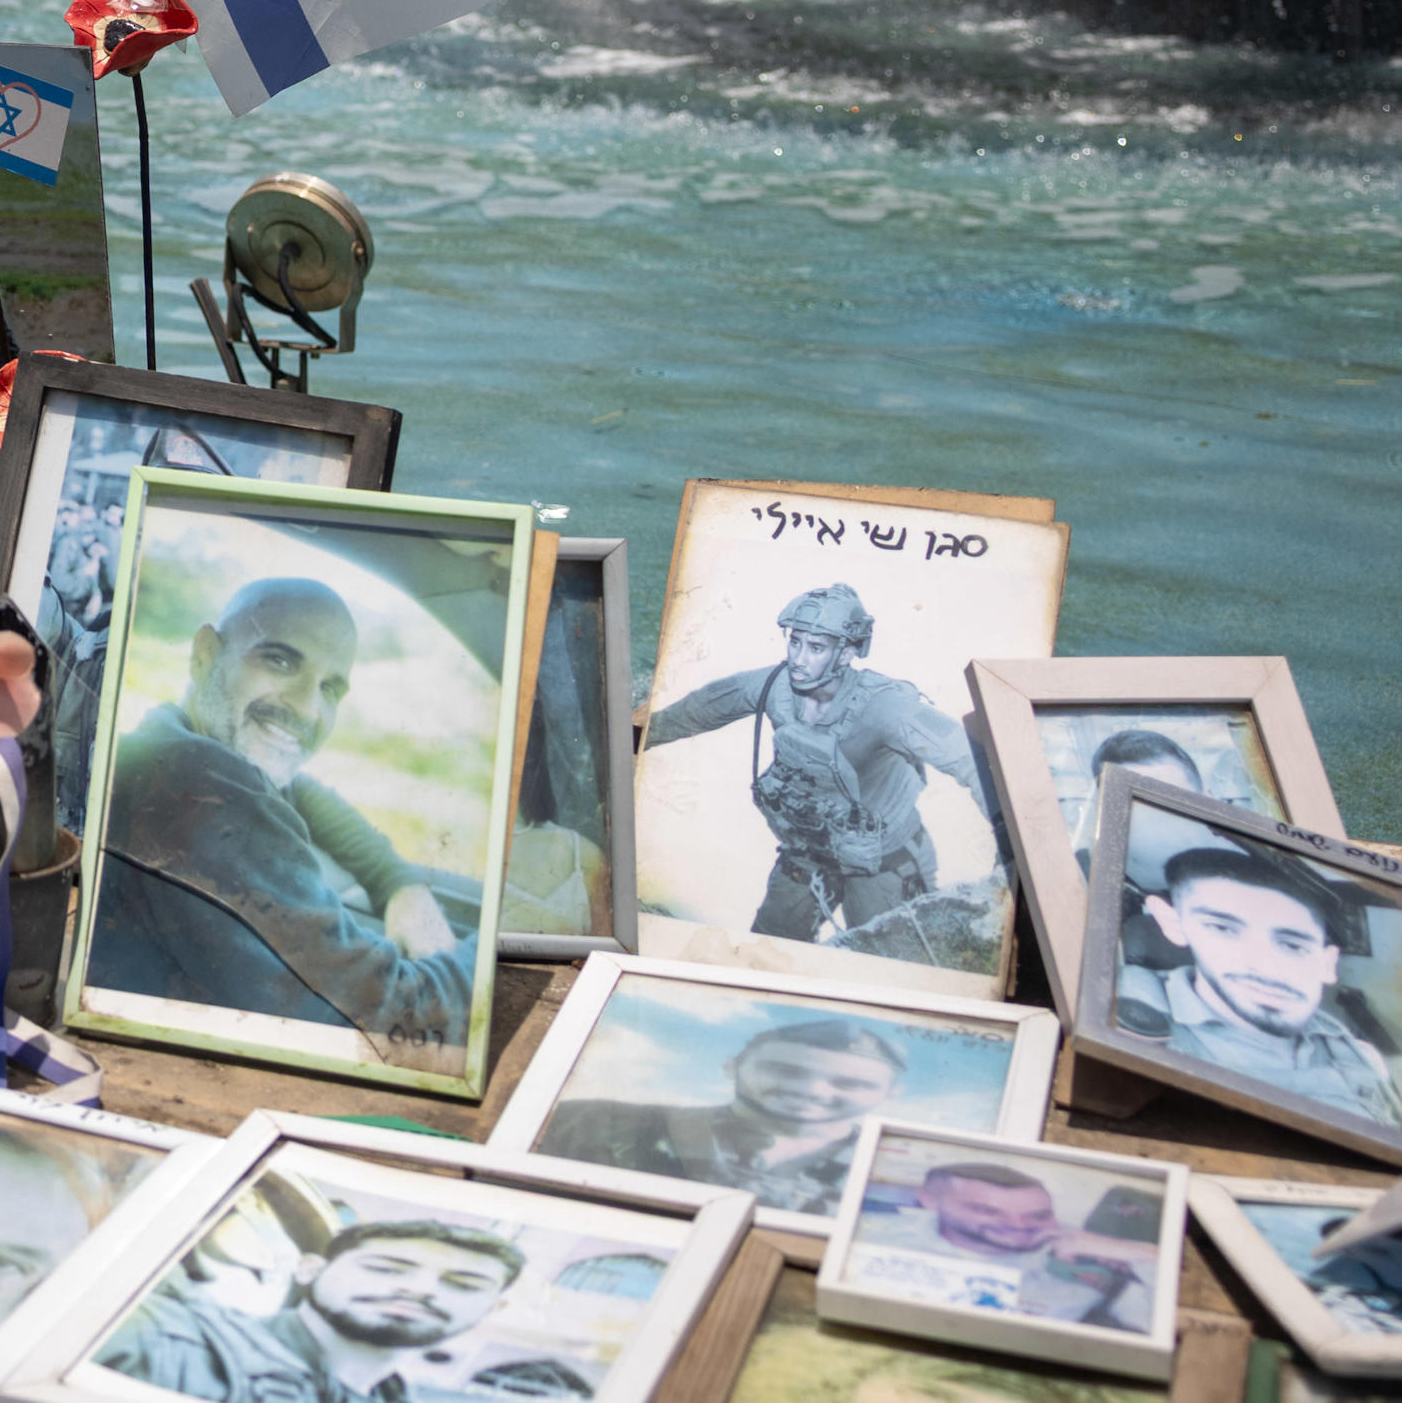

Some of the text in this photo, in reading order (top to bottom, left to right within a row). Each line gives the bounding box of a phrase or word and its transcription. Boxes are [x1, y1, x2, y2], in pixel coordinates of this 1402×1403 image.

[751, 501, 990, 560] סגן שי איילי
